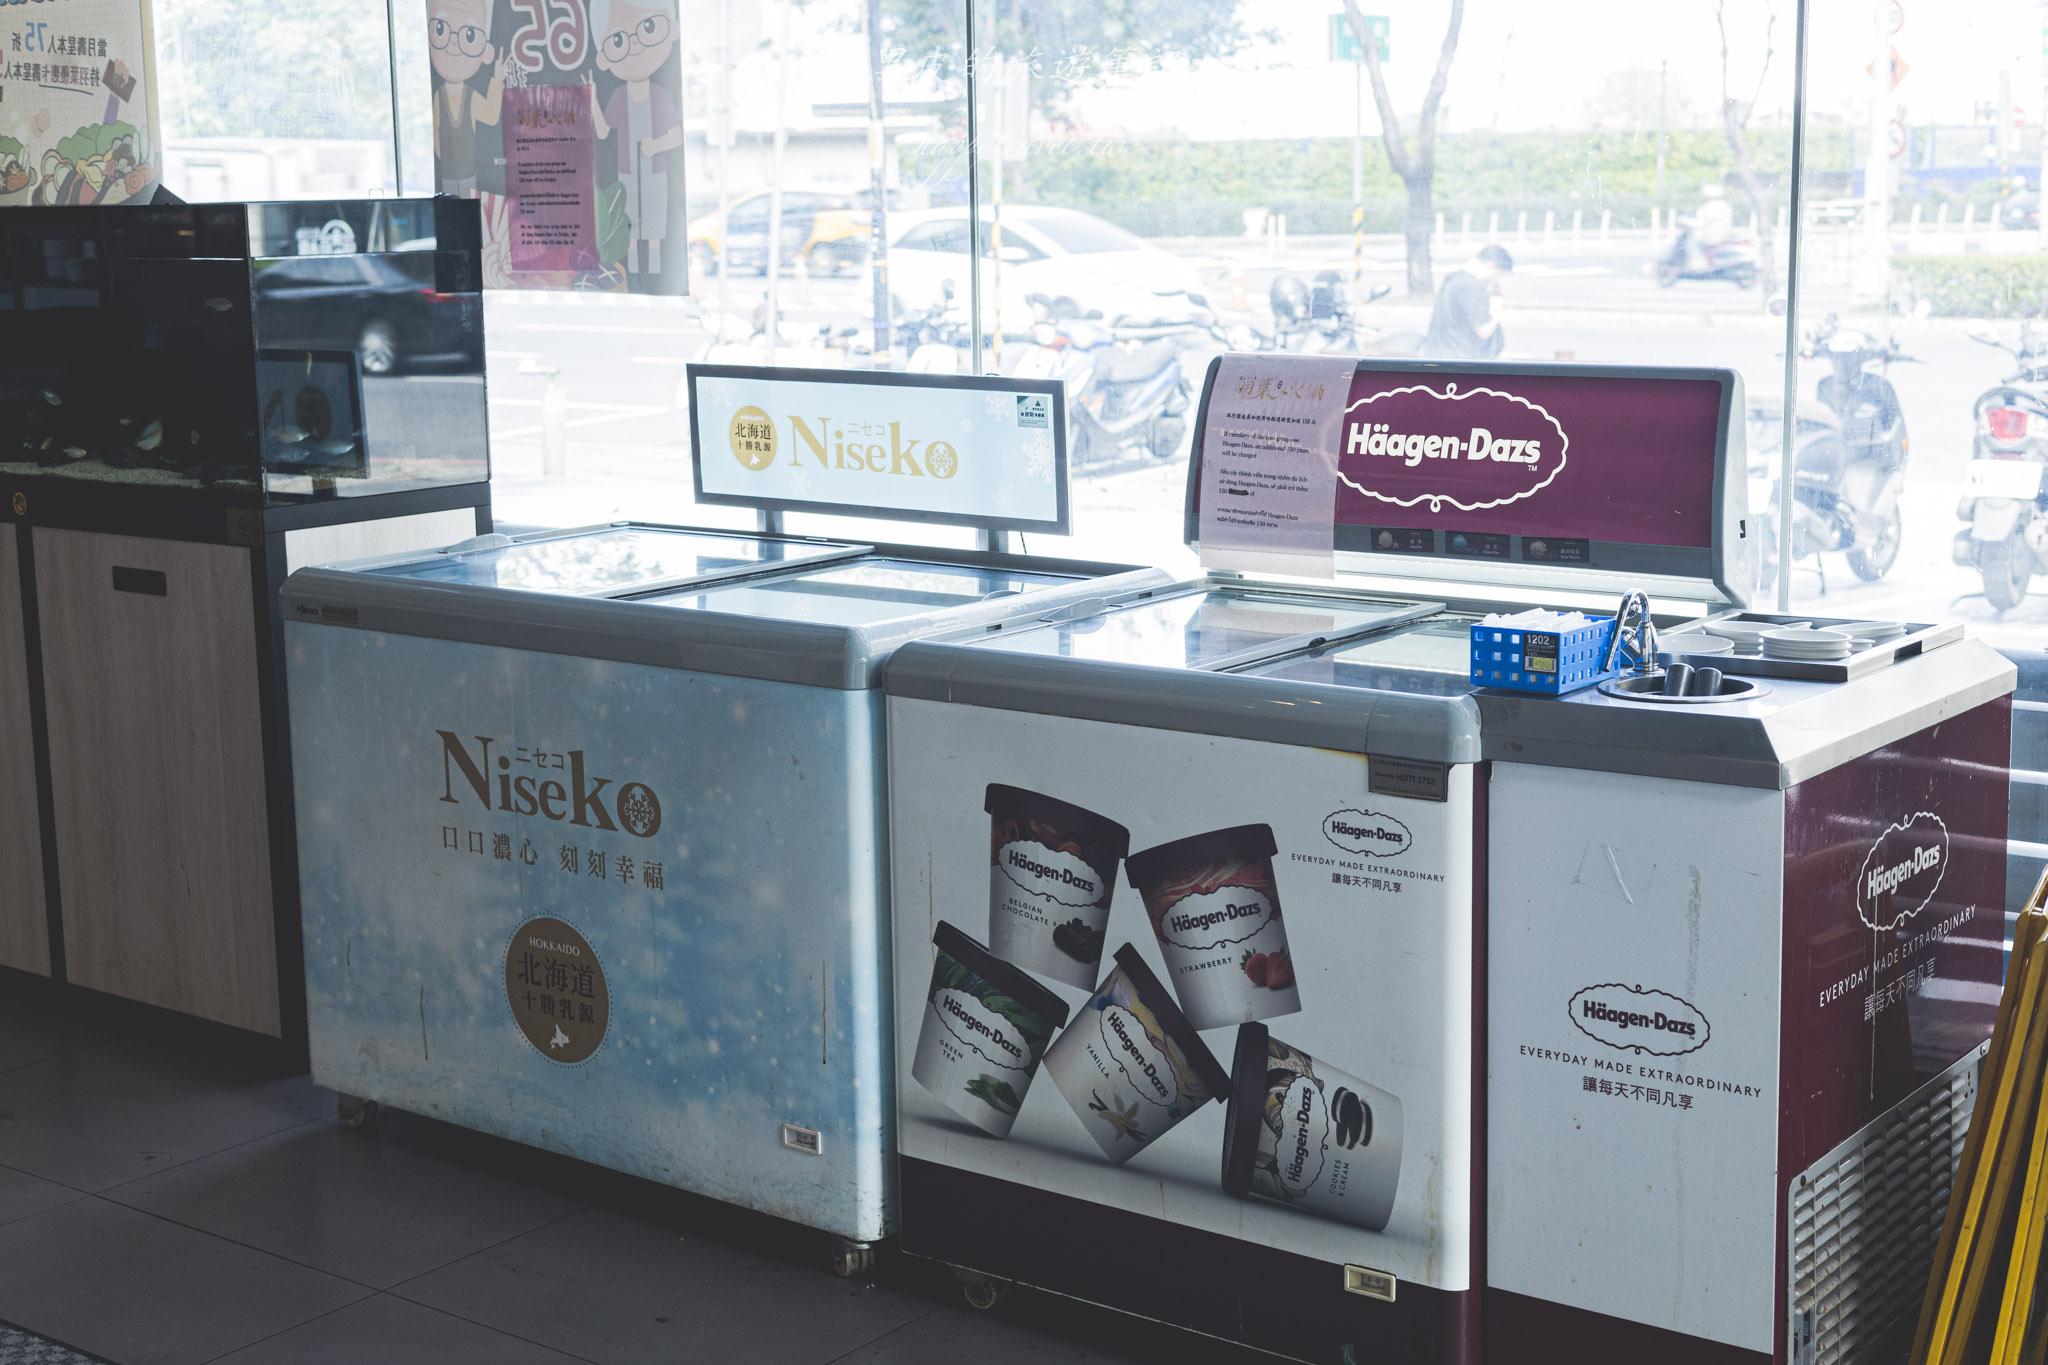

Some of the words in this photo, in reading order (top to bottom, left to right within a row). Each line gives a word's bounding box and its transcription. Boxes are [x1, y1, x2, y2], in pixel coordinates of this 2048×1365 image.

[735, 423, 772, 440] 北海道
[737, 439, 772, 452] 十勝乳源
[848, 422, 886, 436] ニセコ
[1347, 423, 1541, 467] Häagen-Dazs
[787, 415, 959, 480] Niseko
[1527, 634, 1550, 646] 1202
[516, 747, 565, 770] ニセコ
[436, 729, 661, 838] Niseko
[1332, 820, 1403, 843] Häagen-Dazs
[443, 825, 538, 865] 口口濃心
[560, 845, 664, 891] 刻刻幸福
[1008, 849, 1094, 892] Häagen-Dazs
[1291, 853, 1336, 866] EVERYDAY
[1339, 860, 1364, 871] MADE
[1368, 864, 1445, 883] EXTRAORDINARY
[1867, 844, 1940, 899] Häagen-Dazs
[1332, 872, 1402, 893] 讓每天不同凡享
[1001, 903, 1049, 926] CHOCOLATE
[1009, 897, 1043, 914] BELGIAN
[1170, 903, 1261, 933] Häagen-Dazs
[529, 937, 580, 956] HOKKAIDO
[1819, 965, 1869, 1008] EVERYDAY
[1874, 948, 1899, 977] MADE
[1903, 904, 1977, 959] EXTRAORDINARY
[518, 953, 595, 999] 北海道
[1180, 956, 1232, 975] STRAWBERRY
[1864, 957, 1936, 1022] 讓每天不同凡享
[521, 990, 595, 1025] 十勝乳源
[1583, 1000, 1696, 1036] Häagen-Dazs
[943, 995, 1022, 1058] Häagen-Dazs
[939, 1039, 964, 1059] GREEN
[942, 1049, 956, 1062] TEA
[1086, 1043, 1110, 1080] VANILLA
[1107, 1012, 1169, 1098] Häagen-Dazs
[1520, 1045, 1588, 1066] EVERYDAY
[1594, 1058, 1632, 1074] MADE
[1639, 1066, 1761, 1098] EXTRAORDINARY
[1583, 1076, 1693, 1110] 讓每天不同凡享
[1287, 1087, 1312, 1183] Häagen-Dazs
[1328, 1159, 1342, 1194] COOKIES
[1340, 1162, 1350, 1191] CREAM
